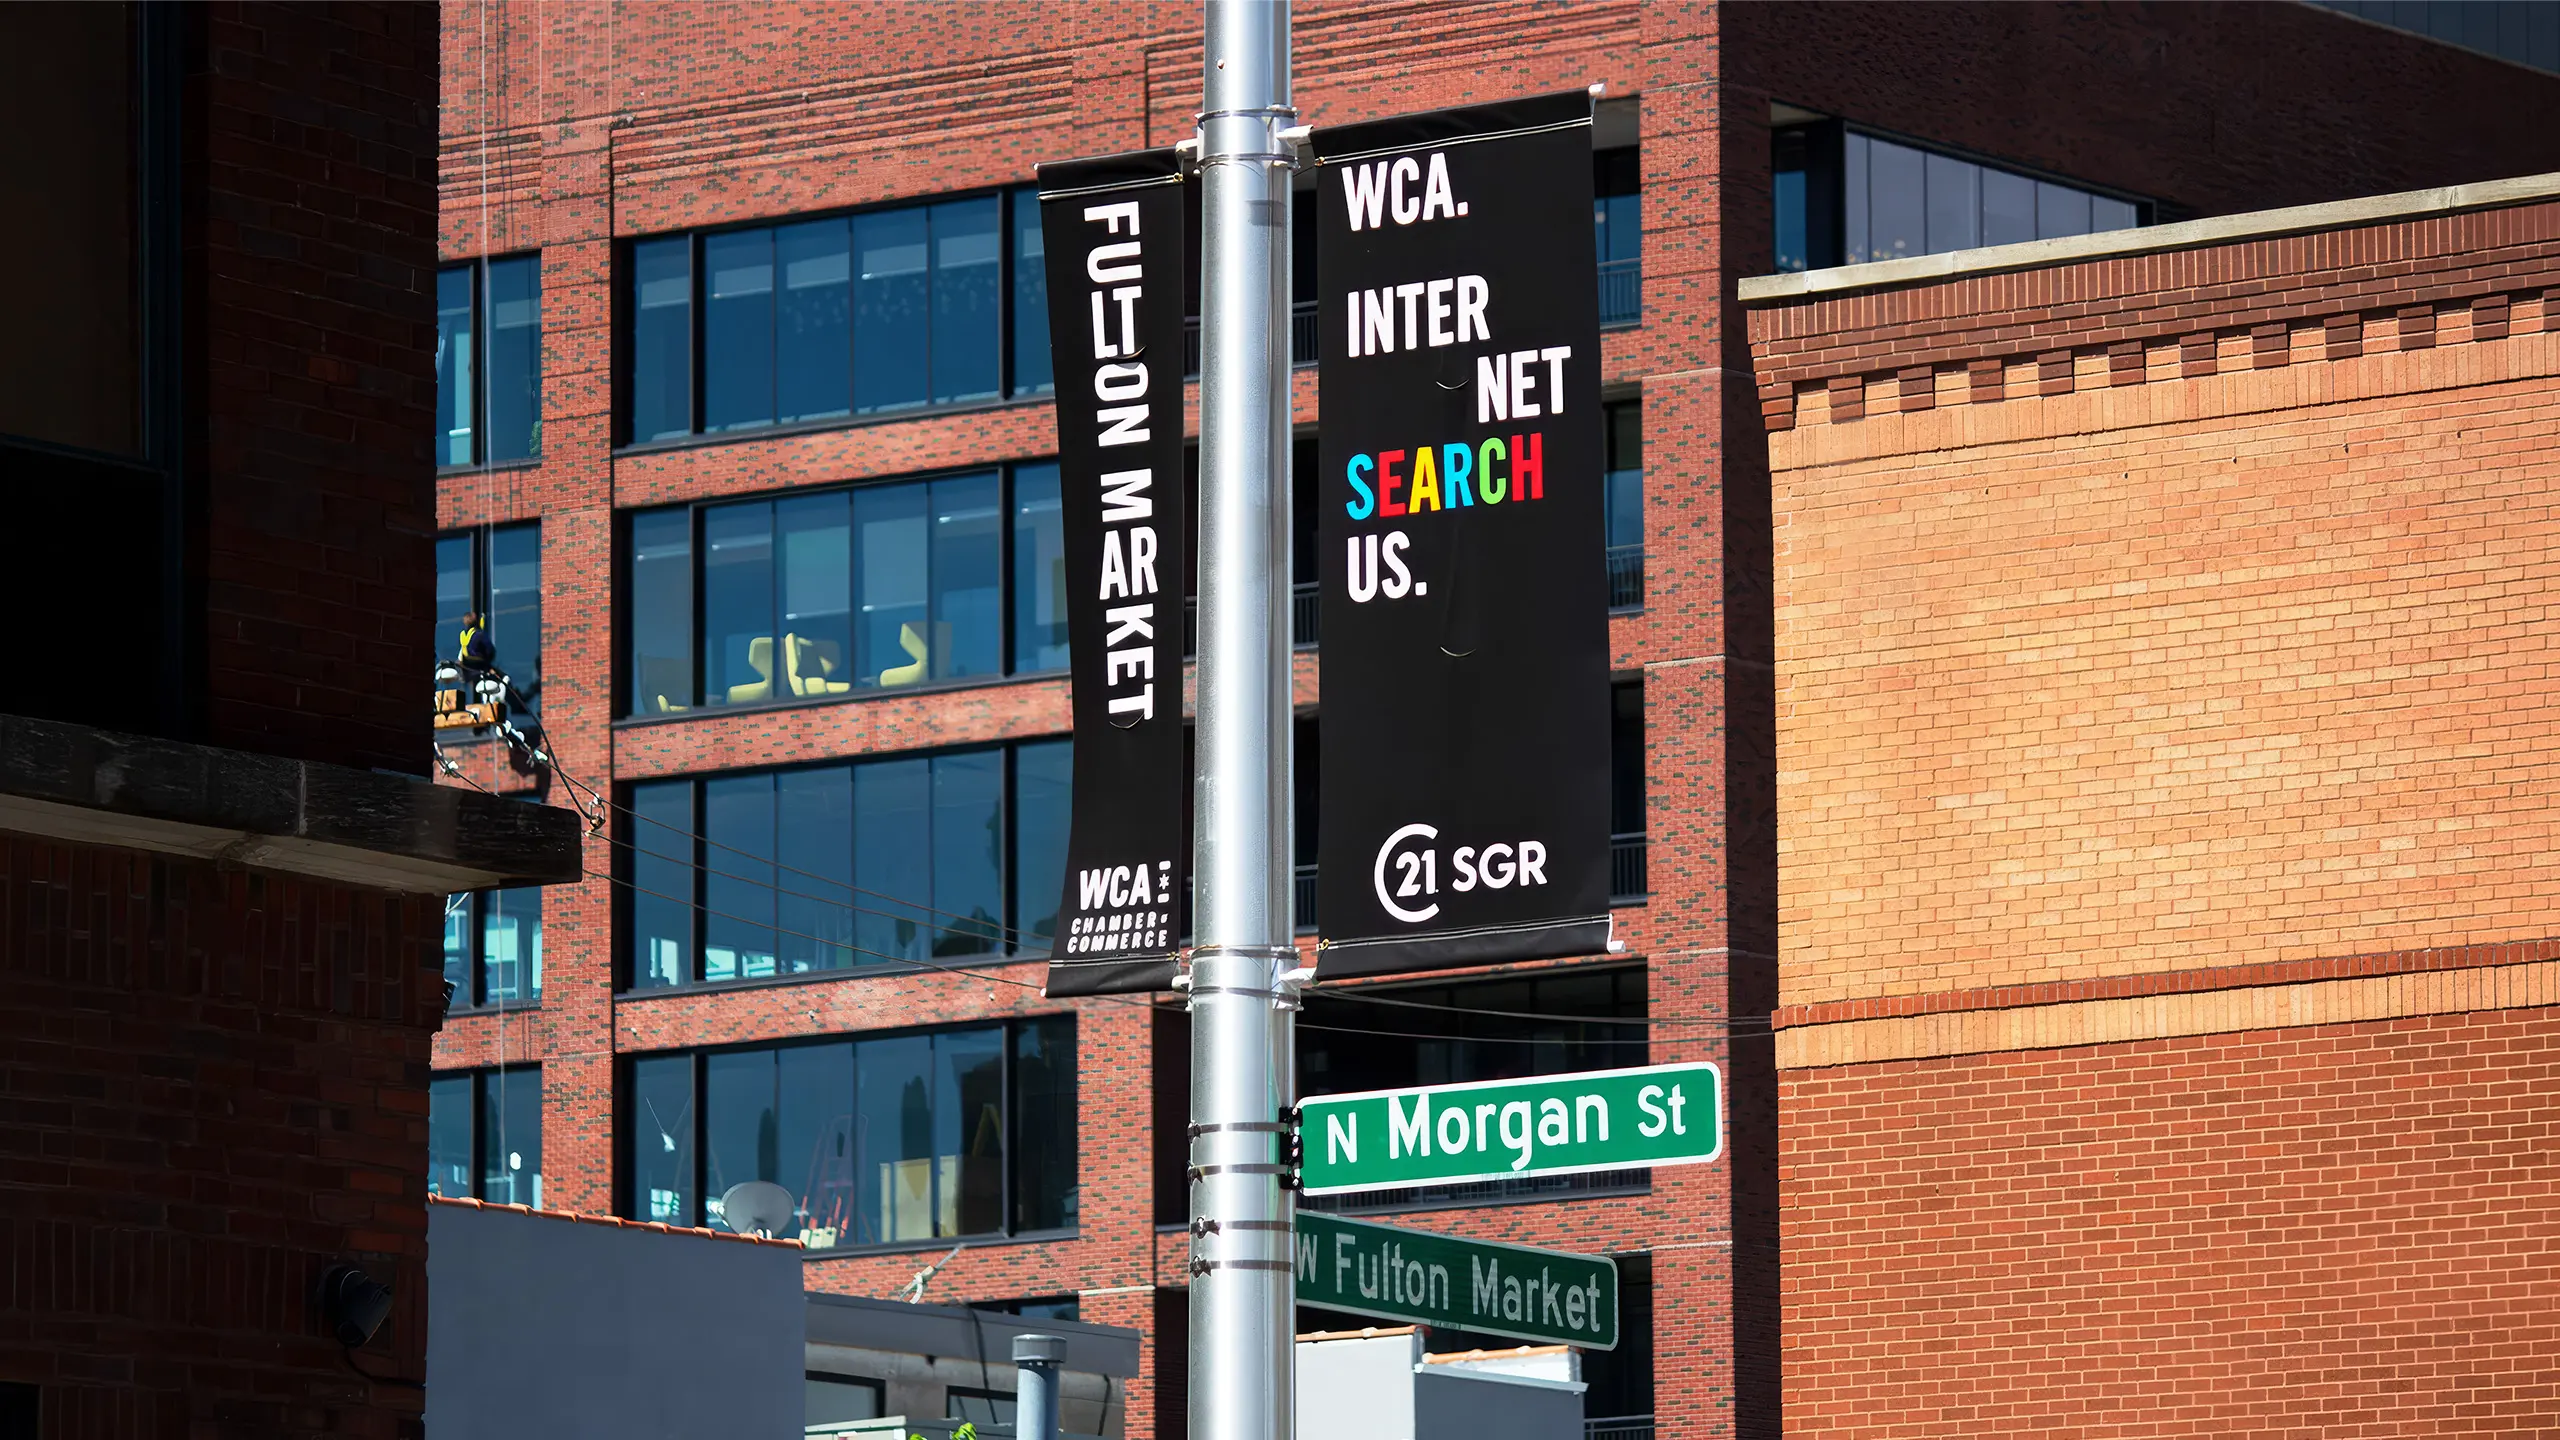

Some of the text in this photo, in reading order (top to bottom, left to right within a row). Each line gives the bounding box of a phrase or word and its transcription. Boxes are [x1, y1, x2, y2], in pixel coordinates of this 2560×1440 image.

[1341, 152, 1469, 231] WCA.
[1348, 275, 1491, 358] INTER
[1477, 345, 1571, 424] NET
[1084, 201, 1158, 720] FULTON MARKET
[1345, 432, 1544, 520] SEARCH
[1347, 531, 1428, 603] US.
[1080, 864, 1151, 911] WCA
[1452, 840, 1548, 892] SGR
[1067, 930, 1168, 954] COMMERCE
[1071, 911, 1157, 935] CHAMBER
[1327, 1083, 1687, 1171] N Morgan St
[1296, 1231, 1602, 1333] W Fulton Market
